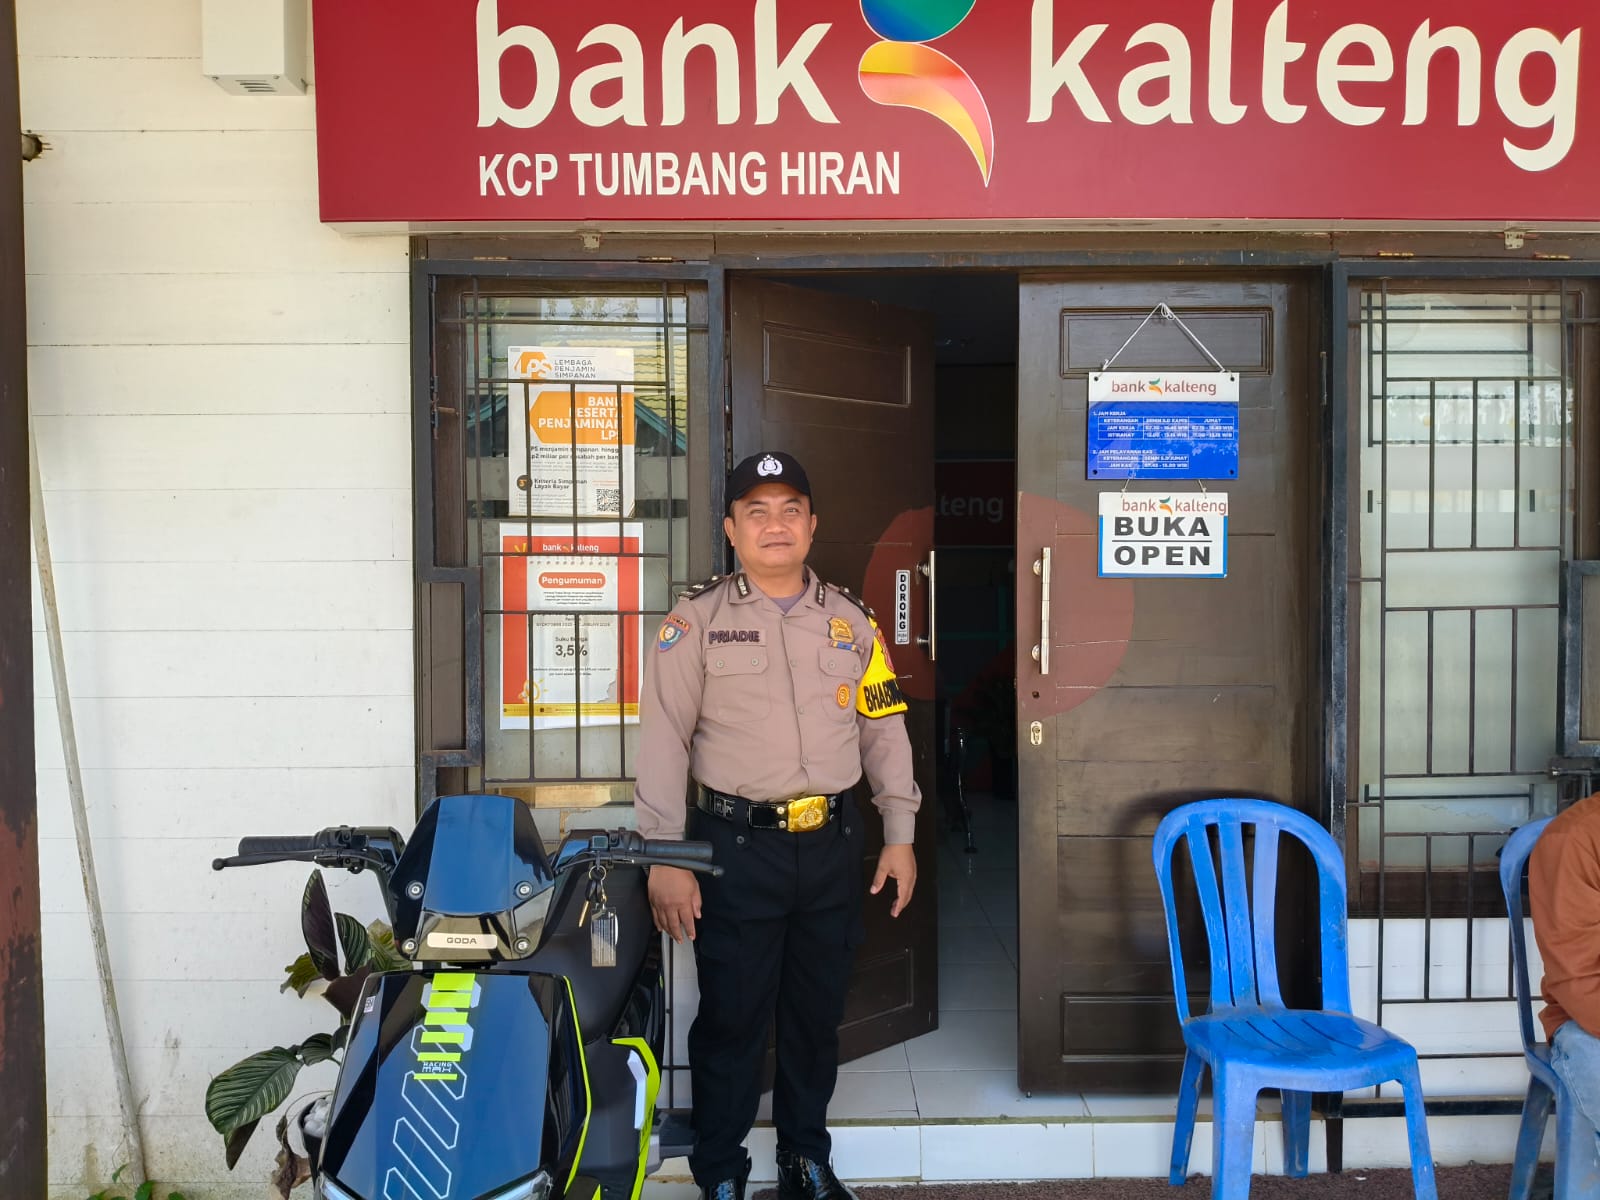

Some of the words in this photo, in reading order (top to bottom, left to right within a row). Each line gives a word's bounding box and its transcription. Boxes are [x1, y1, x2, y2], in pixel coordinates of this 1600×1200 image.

[476, 0, 841, 128] bank
[1026, 0, 1582, 172] kalteng
[478, 153, 558, 197] KCP
[569, 151, 769, 196] TUMBANG
[780, 150, 900, 195] HIRAN
[1112, 380, 1146, 393] bank
[1164, 380, 1217, 396] kalteng
[1122, 498, 1157, 512] bank
[1175, 498, 1227, 516] kalteng
[1114, 516, 1210, 536] BUKA
[542, 543, 562, 551] bank
[1114, 545, 1210, 566] OPEN
[541, 576, 603, 586] Pengumuman
[899, 574, 907, 630] DORONG
[708, 630, 760, 645] PRIADIE
[446, 937, 478, 945] GODA
